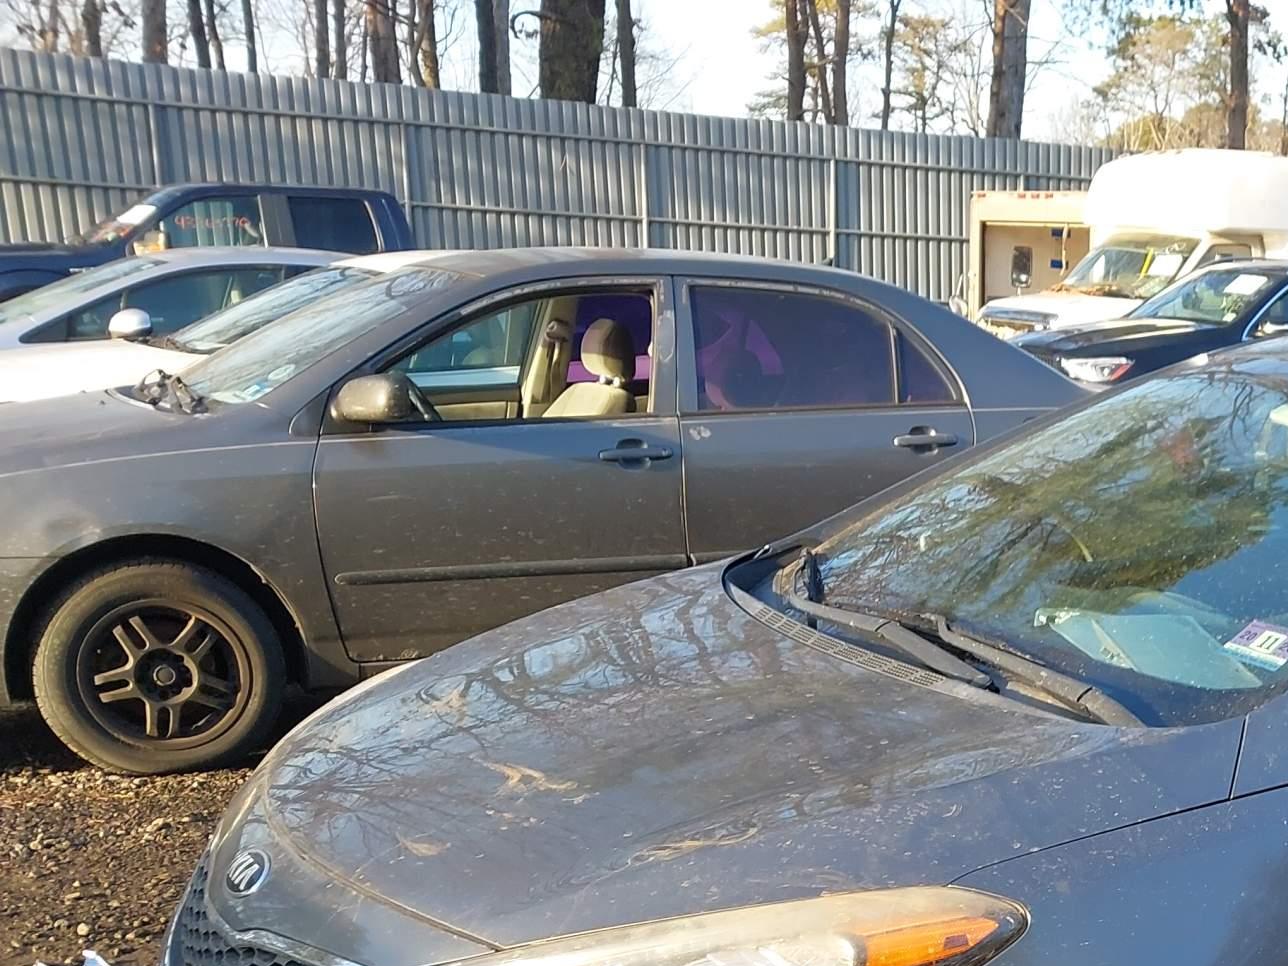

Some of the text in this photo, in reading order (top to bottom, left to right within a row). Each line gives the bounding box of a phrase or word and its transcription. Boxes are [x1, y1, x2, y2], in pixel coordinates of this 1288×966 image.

[1240, 630, 1258, 641] 20
[1257, 635, 1281, 650] 11
[229, 853, 260, 891] KIA
